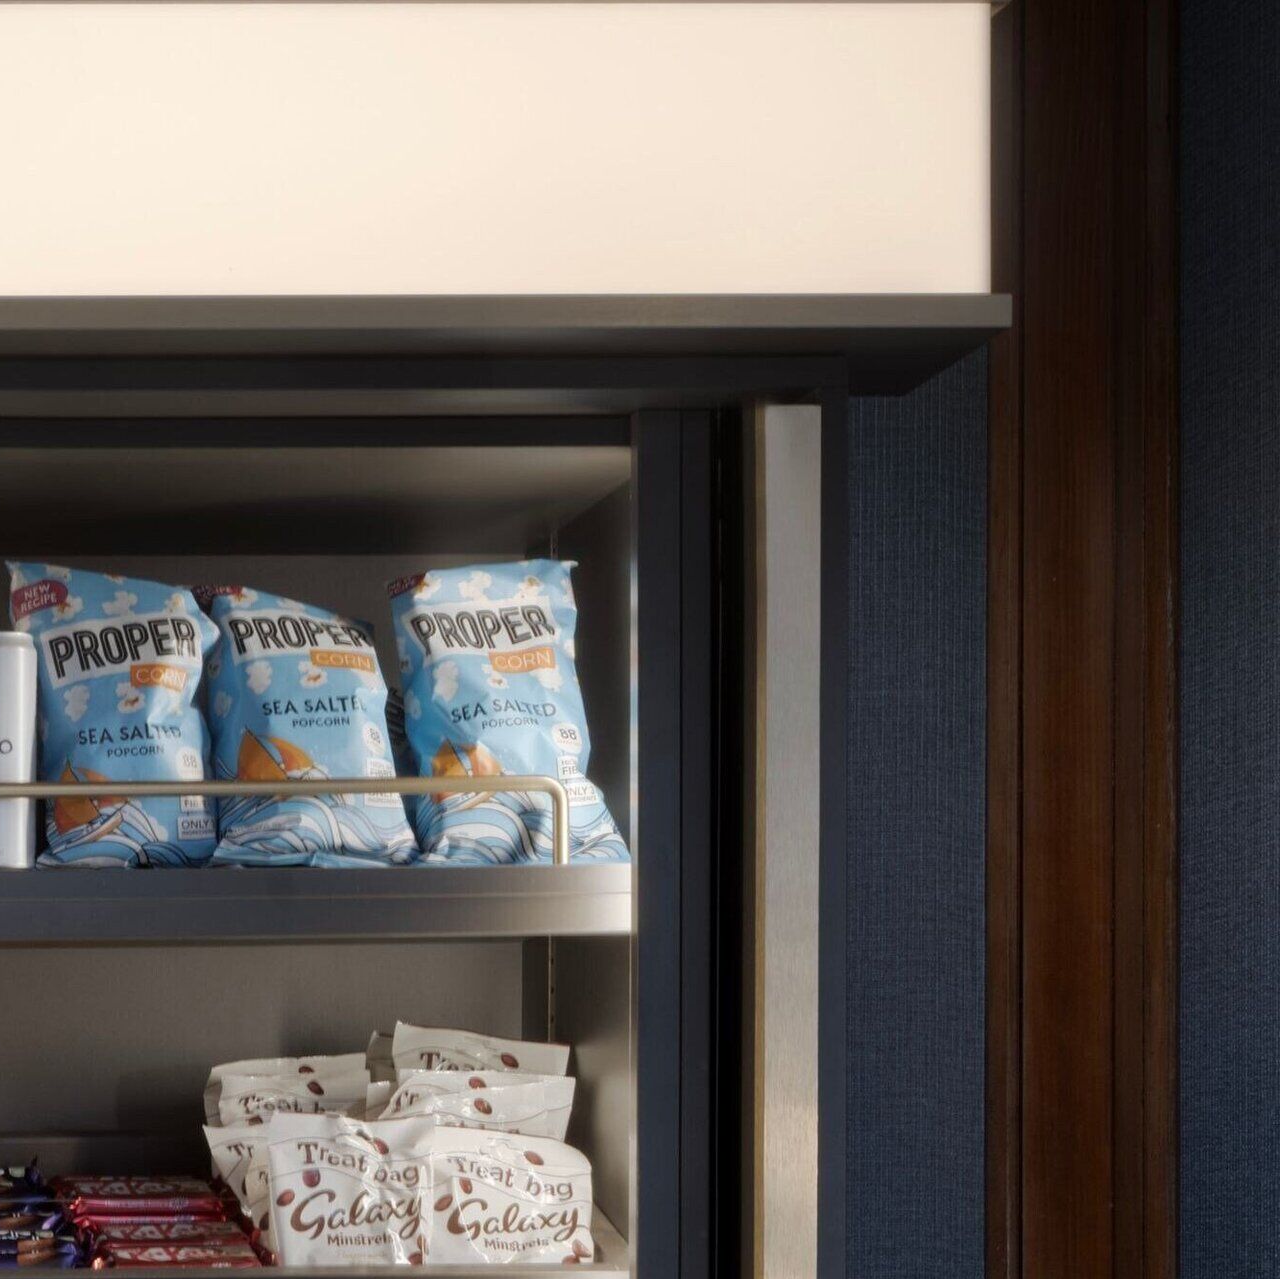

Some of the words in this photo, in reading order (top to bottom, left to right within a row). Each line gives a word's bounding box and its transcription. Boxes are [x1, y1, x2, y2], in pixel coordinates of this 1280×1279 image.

[23, 584, 50, 599] NEW
[20, 593, 57, 612] RECIPE
[230, 612, 374, 654] PROPER
[411, 604, 554, 655] PROPER
[49, 616, 196, 679] PROPER
[315, 653, 372, 669] CORN
[493, 652, 551, 669] CORN
[136, 667, 186, 686] CORN
[262, 699, 298, 715] SEA
[451, 702, 487, 723] SEA
[493, 698, 556, 717] SALTED
[292, 717, 350, 728] POPCORN
[482, 717, 539, 729] POPCORN
[78, 728, 112, 745] SEA
[120, 726, 181, 741] SALTED
[107, 744, 164, 758] POPCORN
[298, 1142, 368, 1172] Treat
[374, 1165, 419, 1187] bag
[448, 1157, 514, 1188] Treat
[526, 1174, 573, 1200] bag
[291, 1189, 422, 1240] Galaxy
[447, 1199, 579, 1242] Galaxy
[484, 1238, 550, 1251] Minstrels
